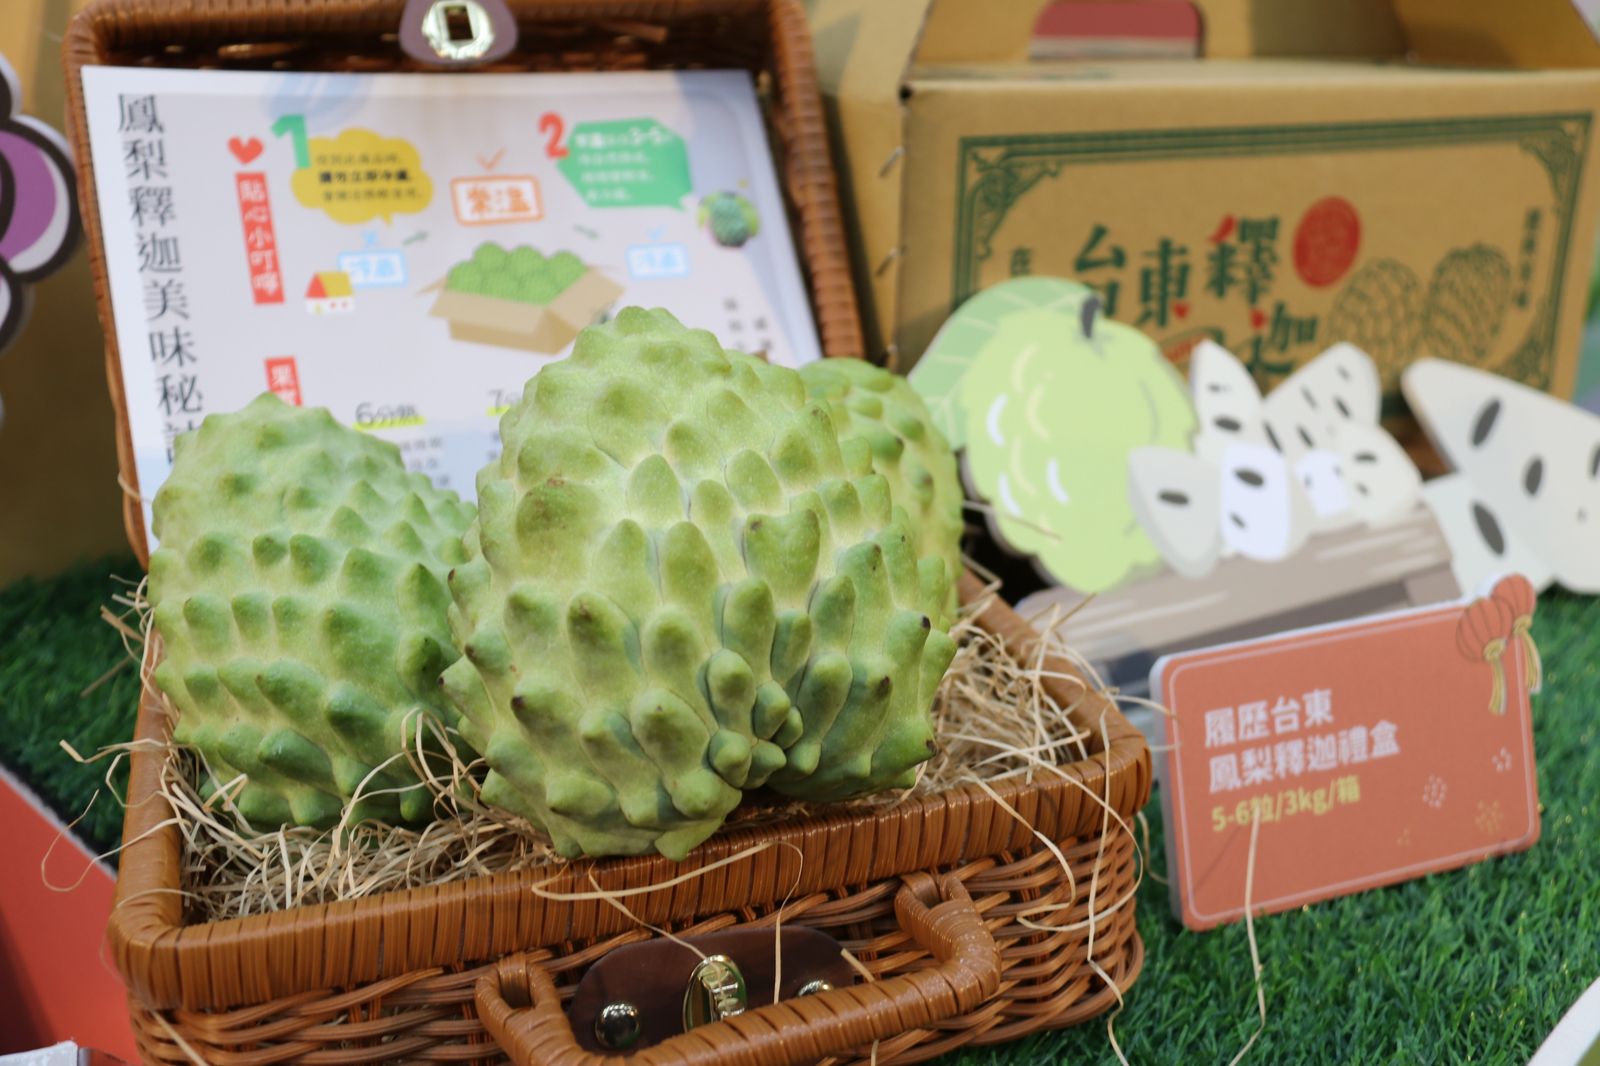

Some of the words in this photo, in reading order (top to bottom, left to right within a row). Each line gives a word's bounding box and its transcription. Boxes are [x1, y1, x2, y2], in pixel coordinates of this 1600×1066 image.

[538, 112, 569, 159] 2
[1204, 689, 1334, 749] 履歷台東
[1208, 719, 1400, 794] 鳳梨釋迦禮盒
